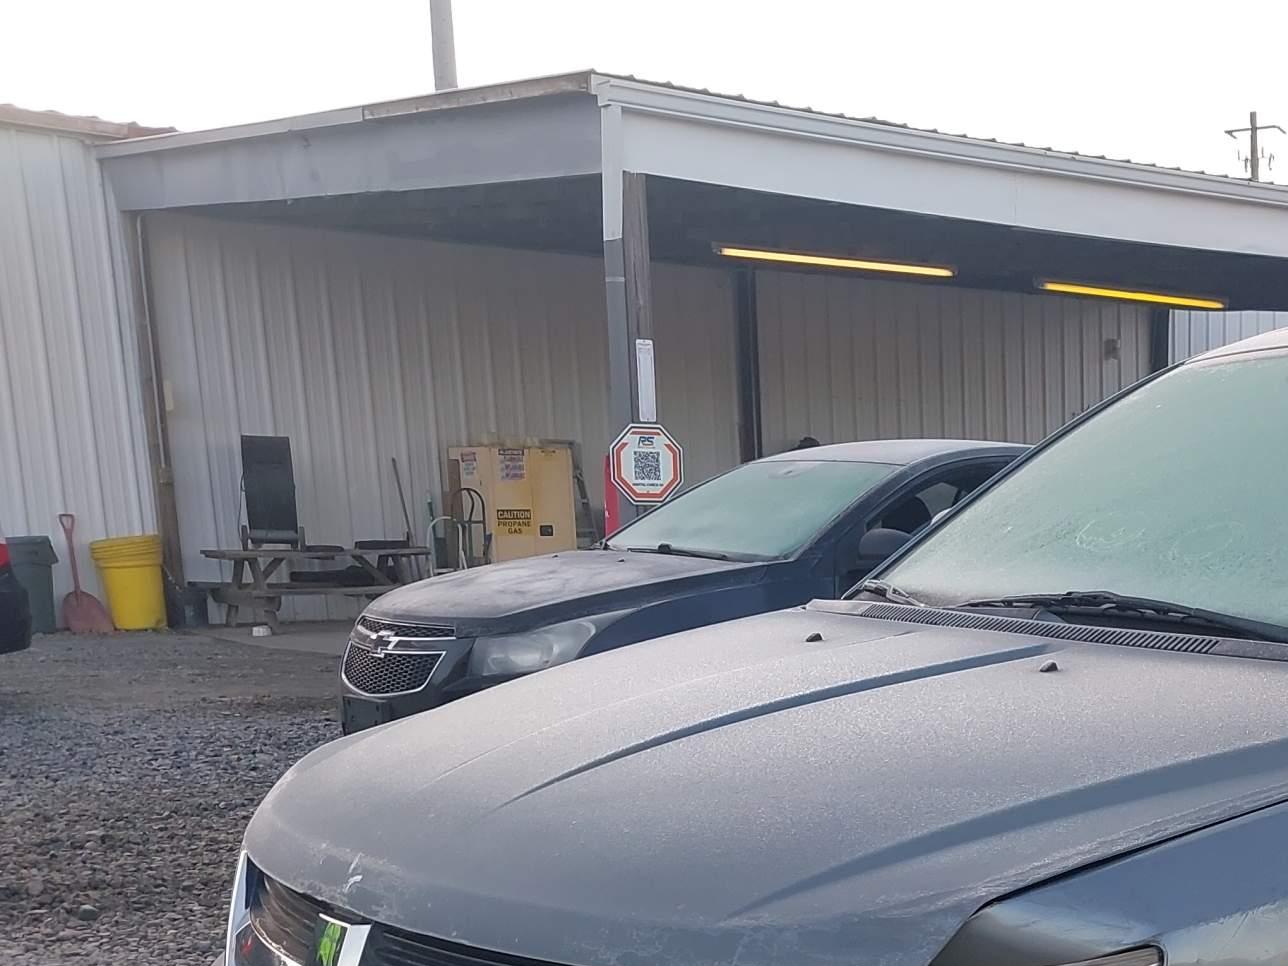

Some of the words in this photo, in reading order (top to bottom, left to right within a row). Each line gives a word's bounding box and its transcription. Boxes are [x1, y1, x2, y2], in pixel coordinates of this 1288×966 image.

[498, 510, 531, 519] CAUTION
[497, 520, 531, 528] PROPANE
[507, 527, 523, 535] GAS
